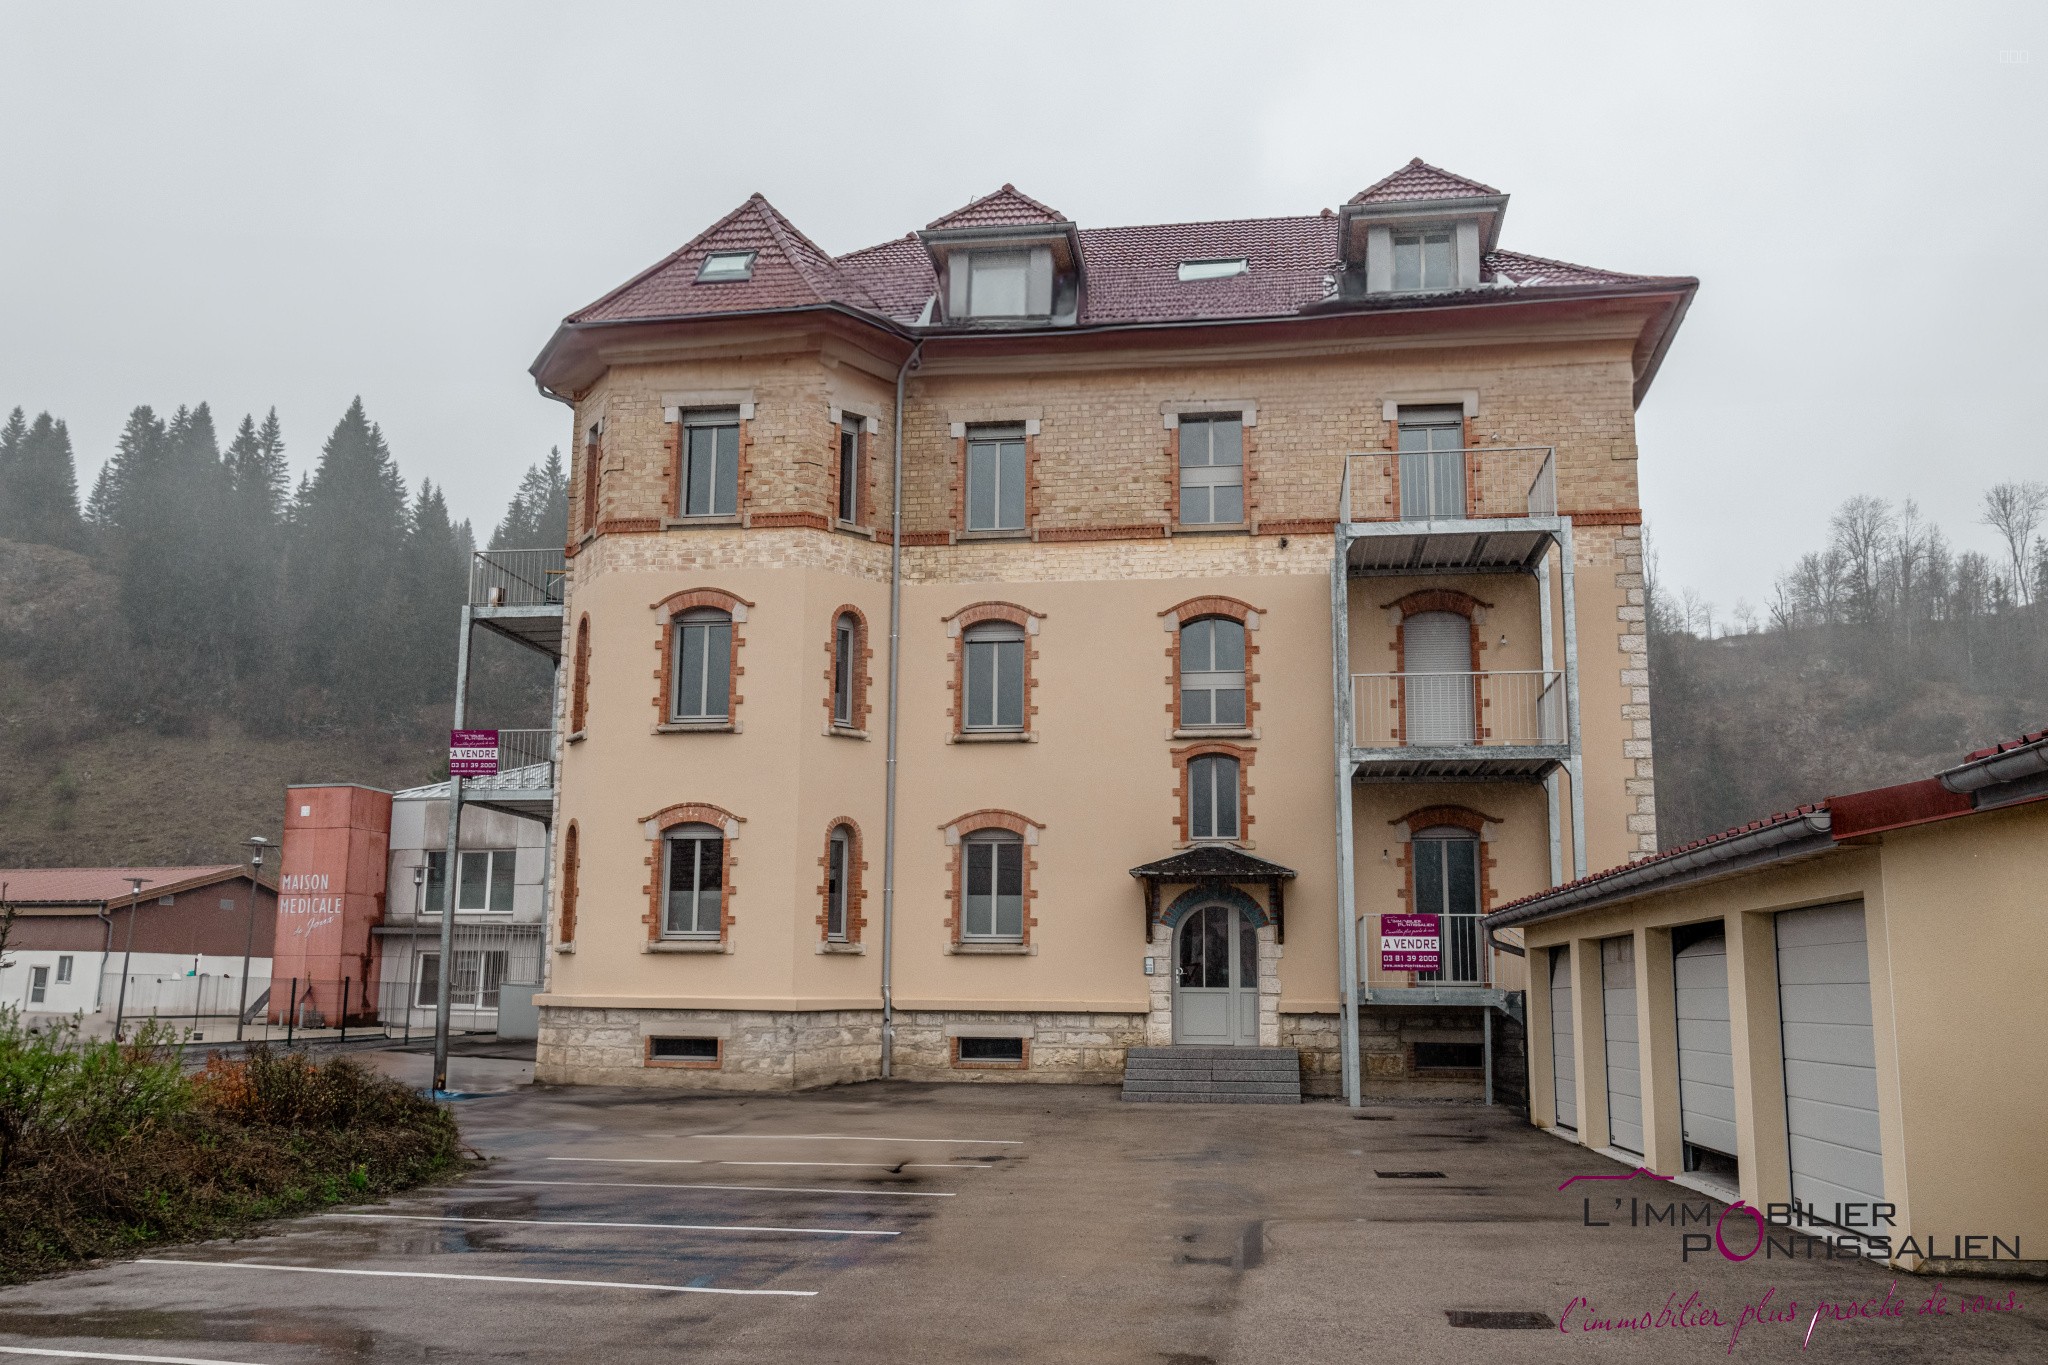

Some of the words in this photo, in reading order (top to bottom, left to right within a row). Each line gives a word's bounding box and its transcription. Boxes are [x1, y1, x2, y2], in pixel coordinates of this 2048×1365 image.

[452, 750, 458, 758] A
[461, 750, 496, 758] VENDRE
[282, 874, 329, 890] MAISON
[280, 898, 342, 914] MEDICALE
[1384, 939, 1391, 949] A
[1394, 939, 1437, 949] VENDRE
